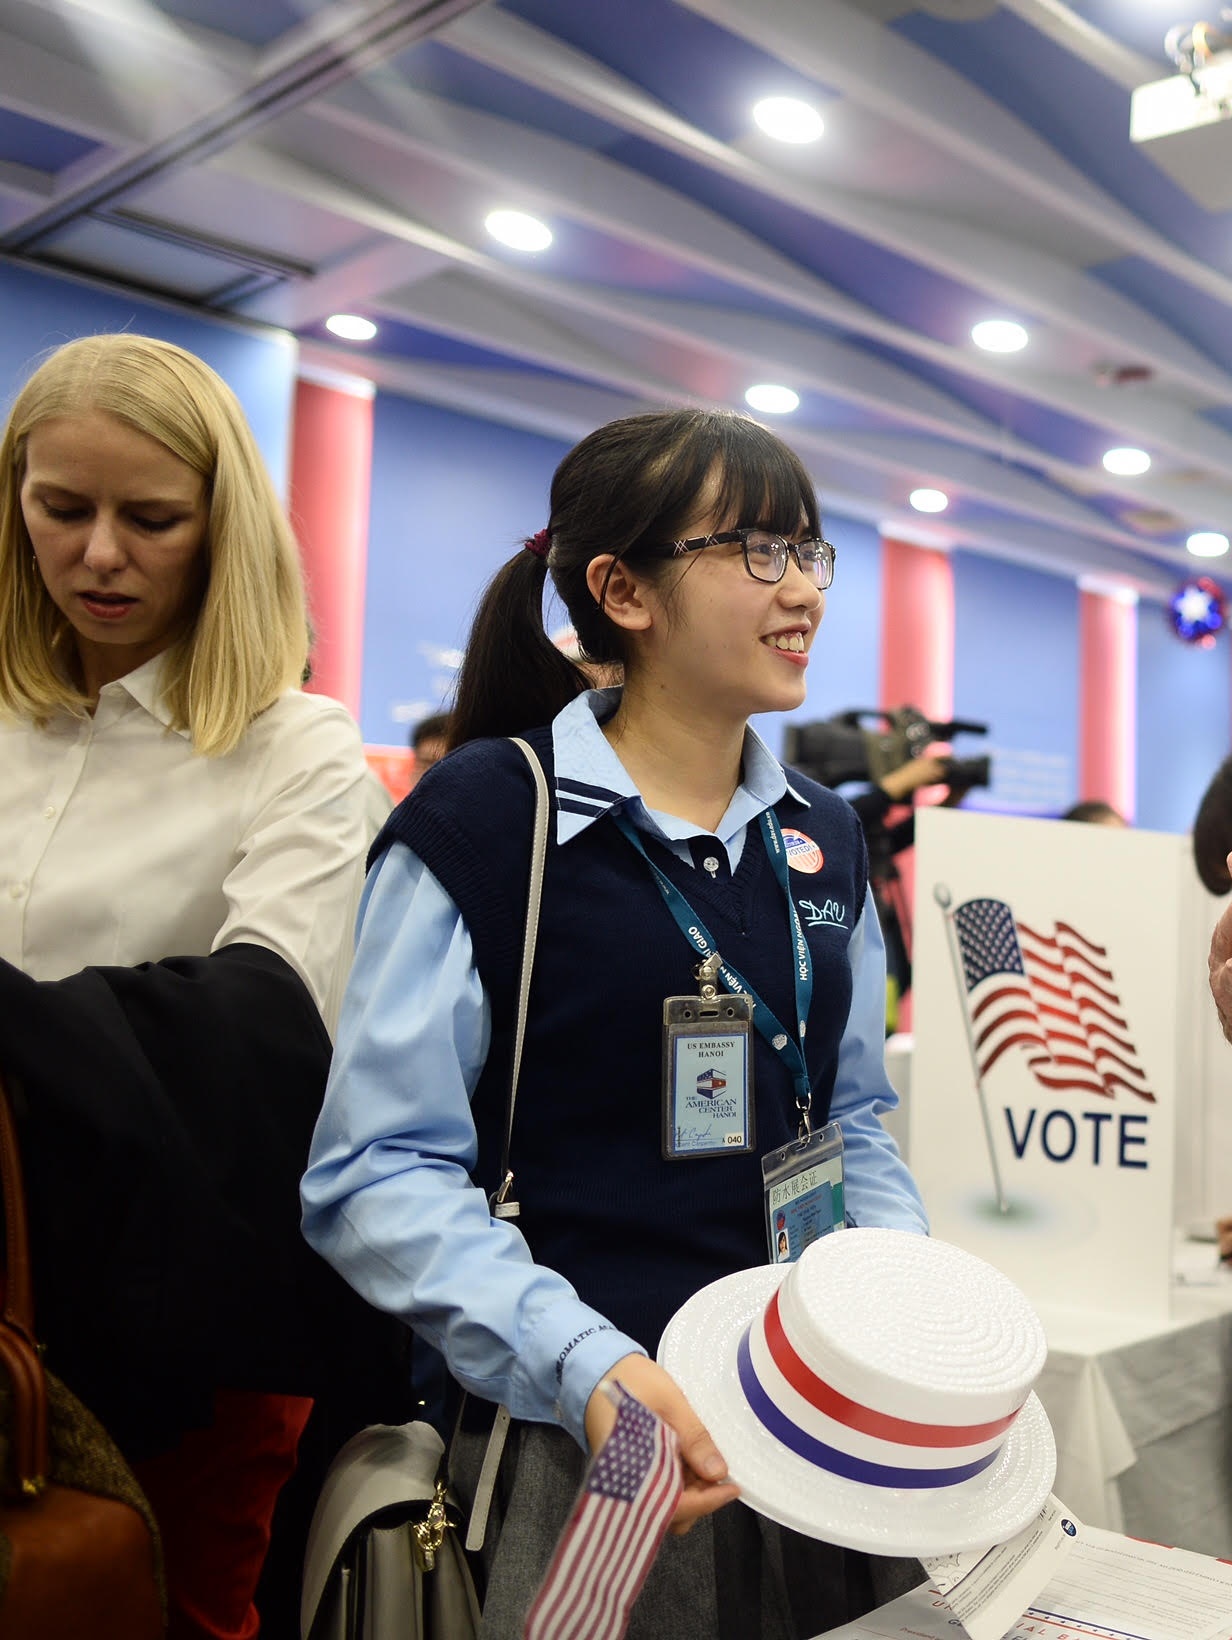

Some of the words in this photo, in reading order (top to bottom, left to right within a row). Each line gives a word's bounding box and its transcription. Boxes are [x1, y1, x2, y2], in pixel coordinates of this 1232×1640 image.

[688, 926, 708, 949] GIAO
[699, 1041, 736, 1049] EMBASSY
[685, 1098, 737, 1109] AMERICAN
[698, 1106, 733, 1114] CENTER
[1004, 1107, 1148, 1170] VOTE
